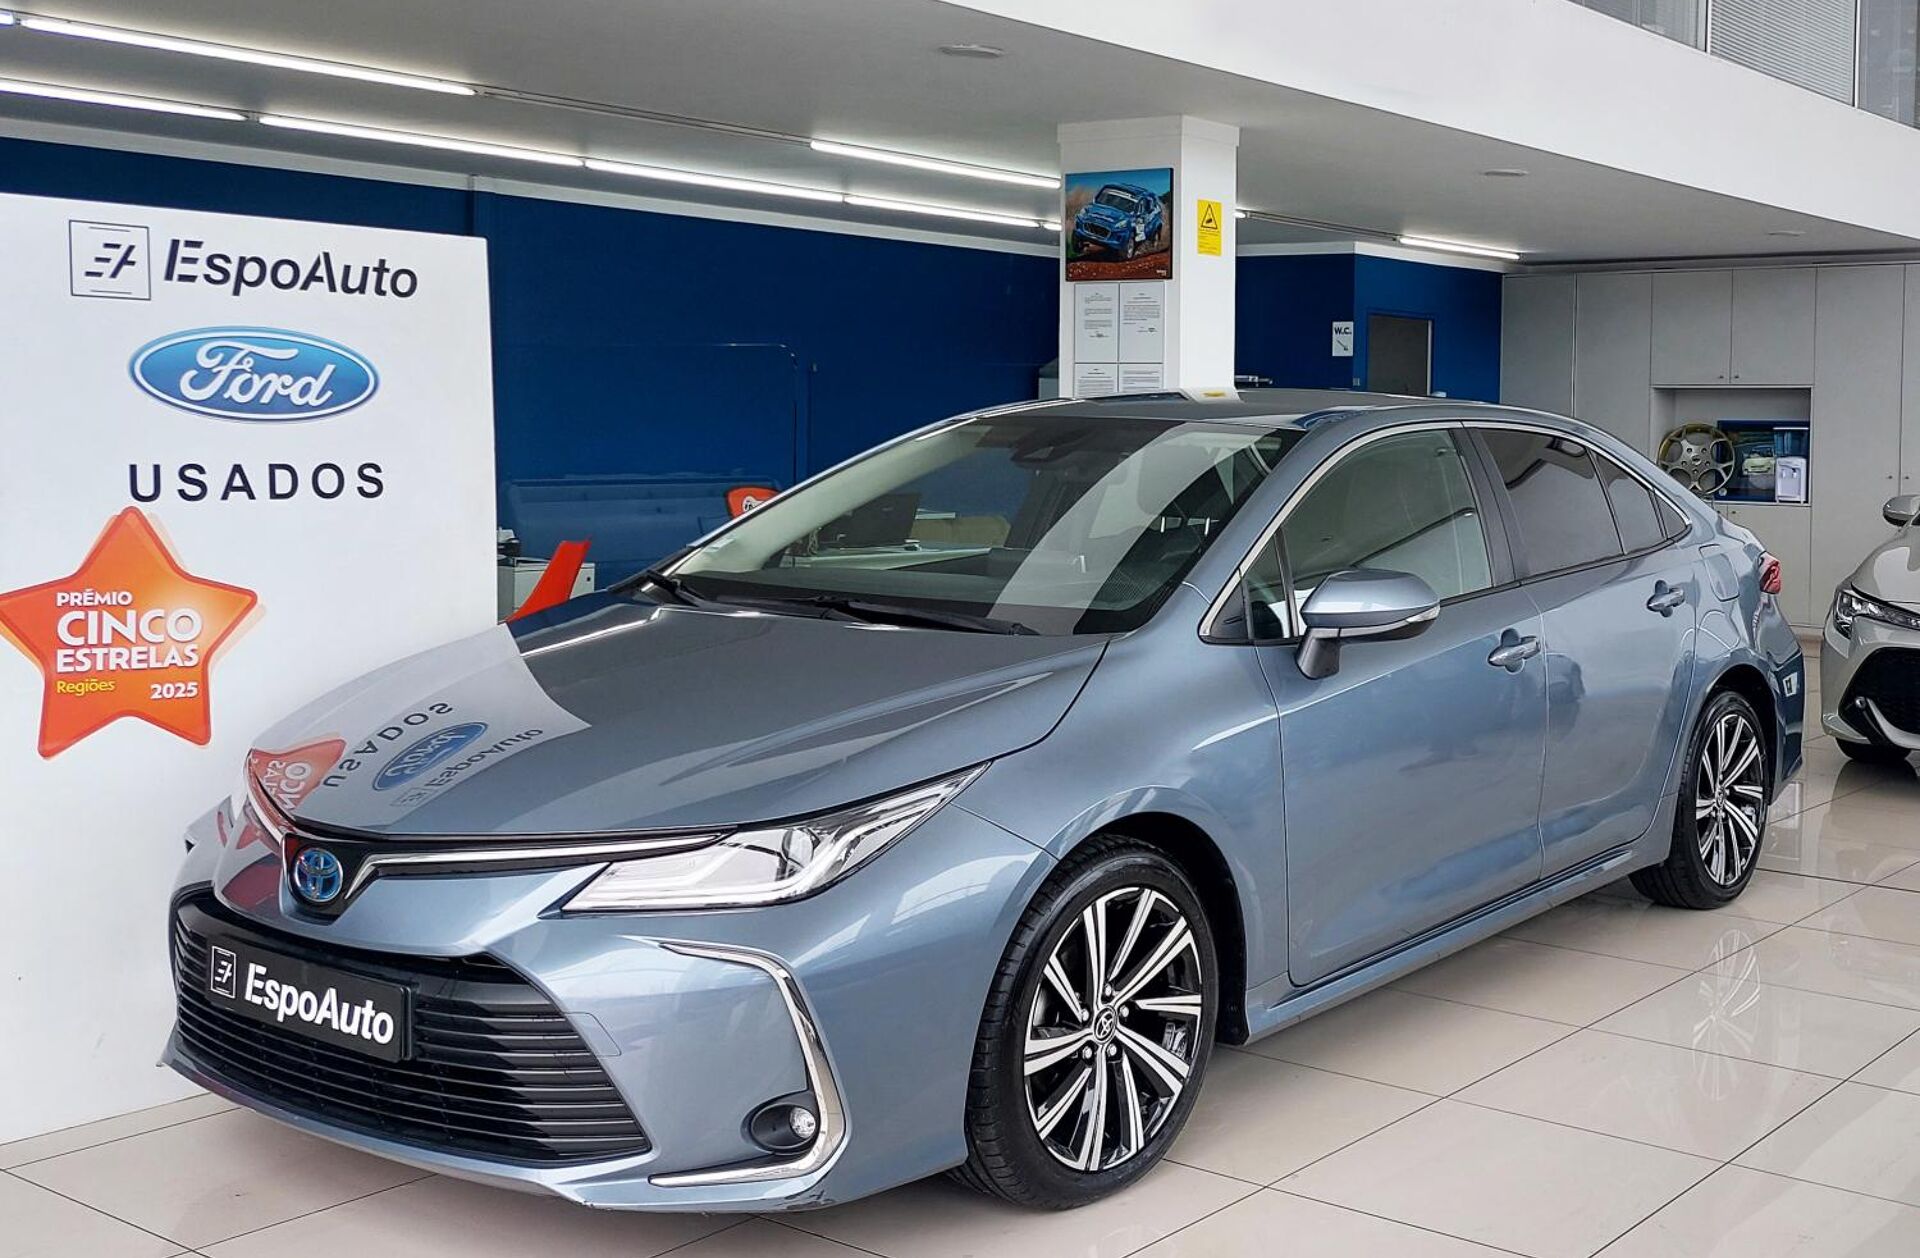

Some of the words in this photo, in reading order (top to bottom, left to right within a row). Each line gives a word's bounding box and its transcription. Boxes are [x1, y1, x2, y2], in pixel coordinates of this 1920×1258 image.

[164, 238, 418, 298] EspoAuto
[180, 340, 338, 409] Ford
[129, 462, 386, 503] USADOS
[56, 588, 133, 608] PRÉMIO
[56, 608, 203, 646] CINCO
[56, 646, 200, 673] ESTRELAS
[56, 677, 116, 695] Regiões
[150, 681, 199, 700] 2025
[244, 963, 395, 1046] EspoAuto
